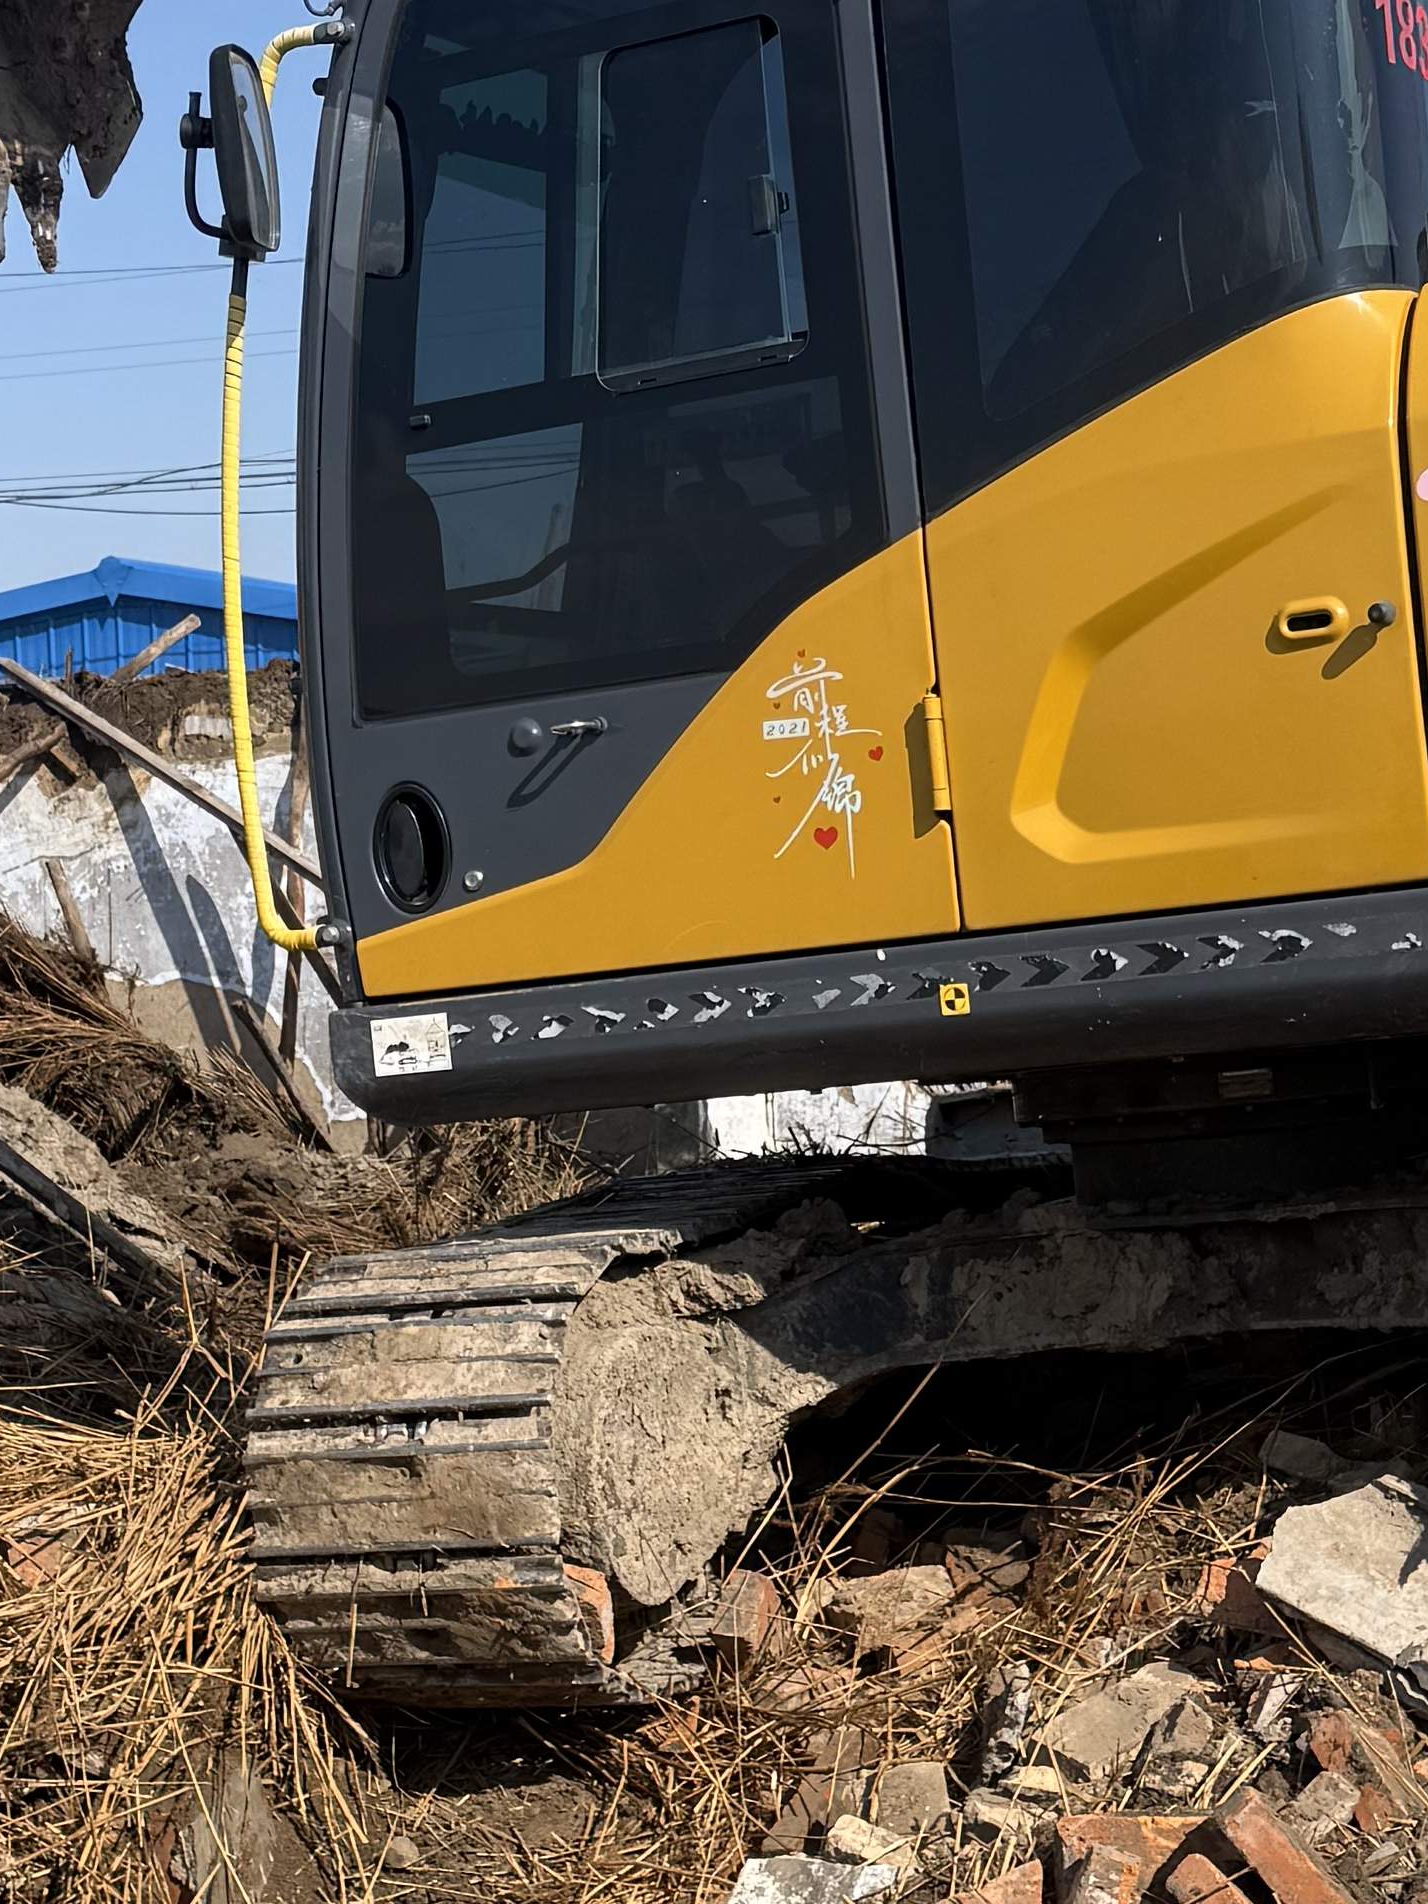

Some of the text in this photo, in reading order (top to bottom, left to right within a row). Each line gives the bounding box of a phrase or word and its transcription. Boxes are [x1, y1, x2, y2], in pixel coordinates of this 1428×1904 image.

[765, 657, 883, 880] 前程似锦
[766, 720, 808, 737] 2021
